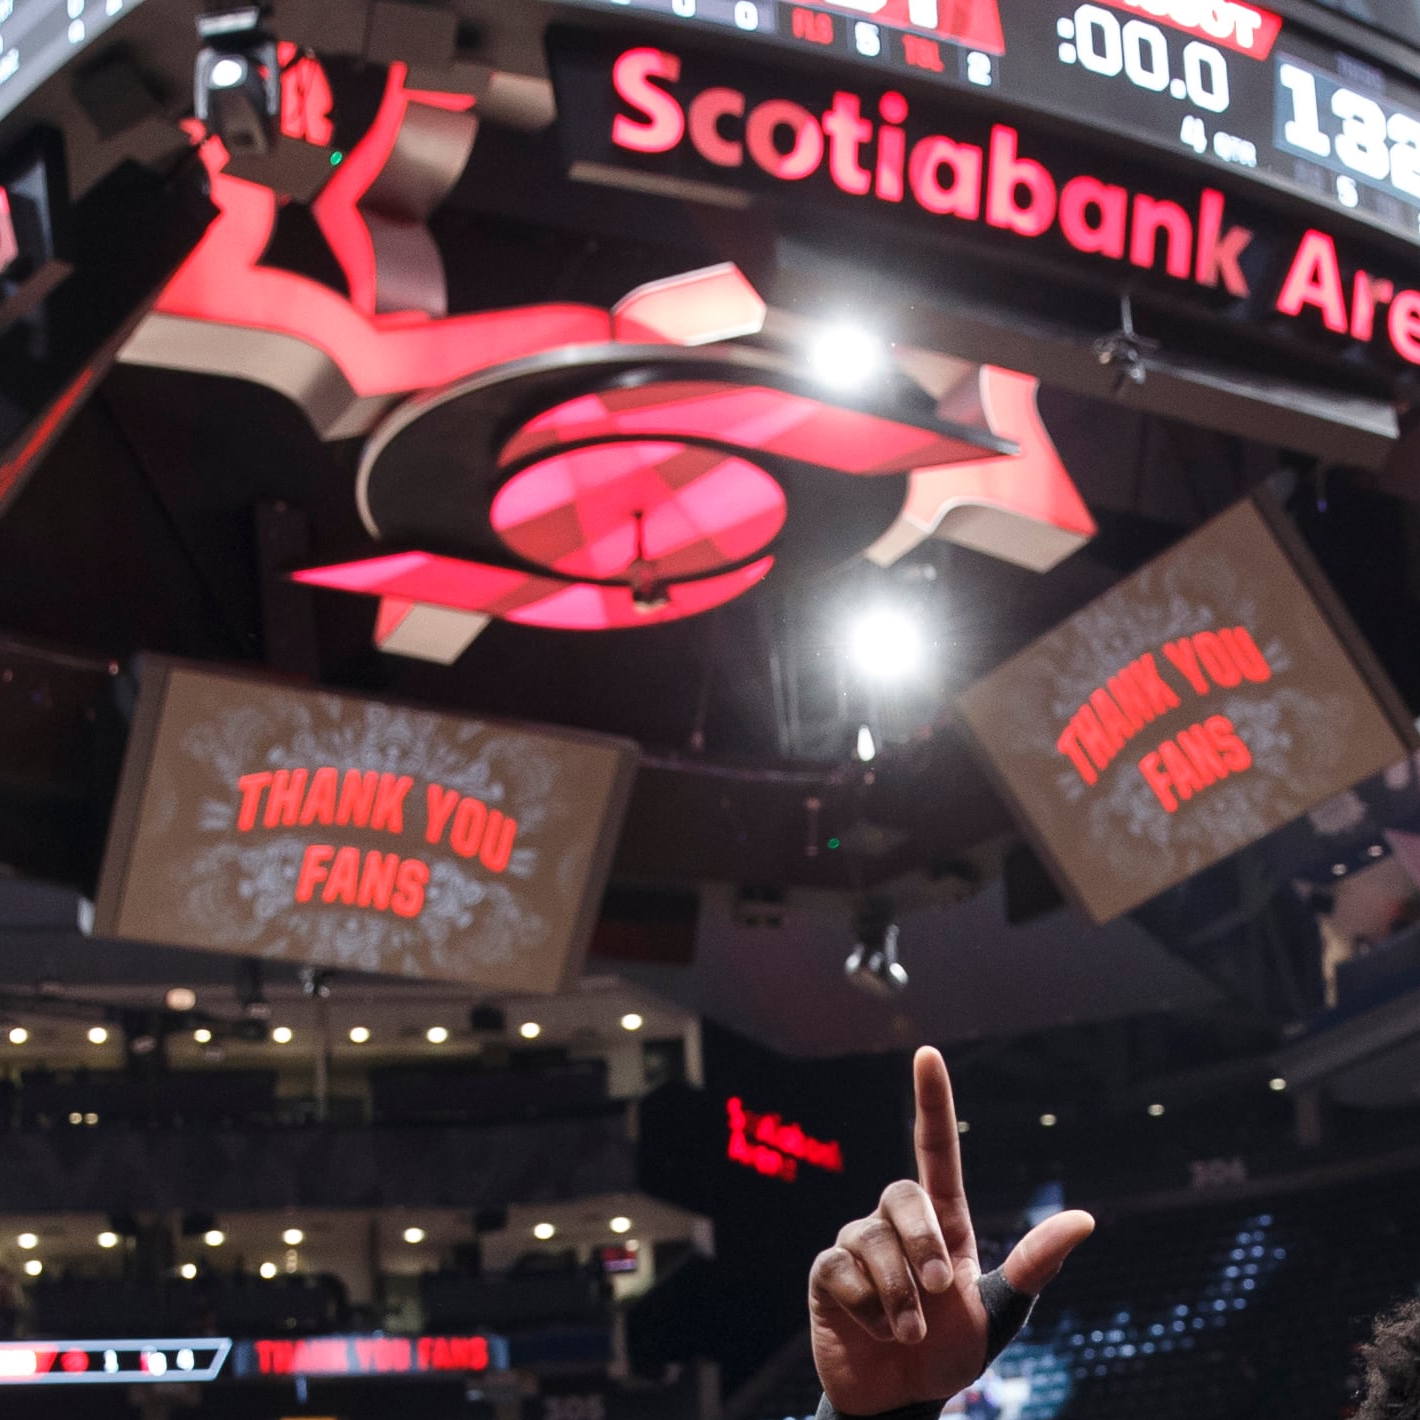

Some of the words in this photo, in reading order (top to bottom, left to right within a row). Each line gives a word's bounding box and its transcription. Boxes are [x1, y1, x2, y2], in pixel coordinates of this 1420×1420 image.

[611, 46, 1254, 298] Scotiabank
[1056, 652, 1180, 786] THANK
[1162, 625, 1272, 695] YOU
[1138, 714, 1253, 813] FANS
[236, 766, 413, 832] THANK
[425, 783, 517, 872] YOU
[295, 844, 430, 918] FANS
